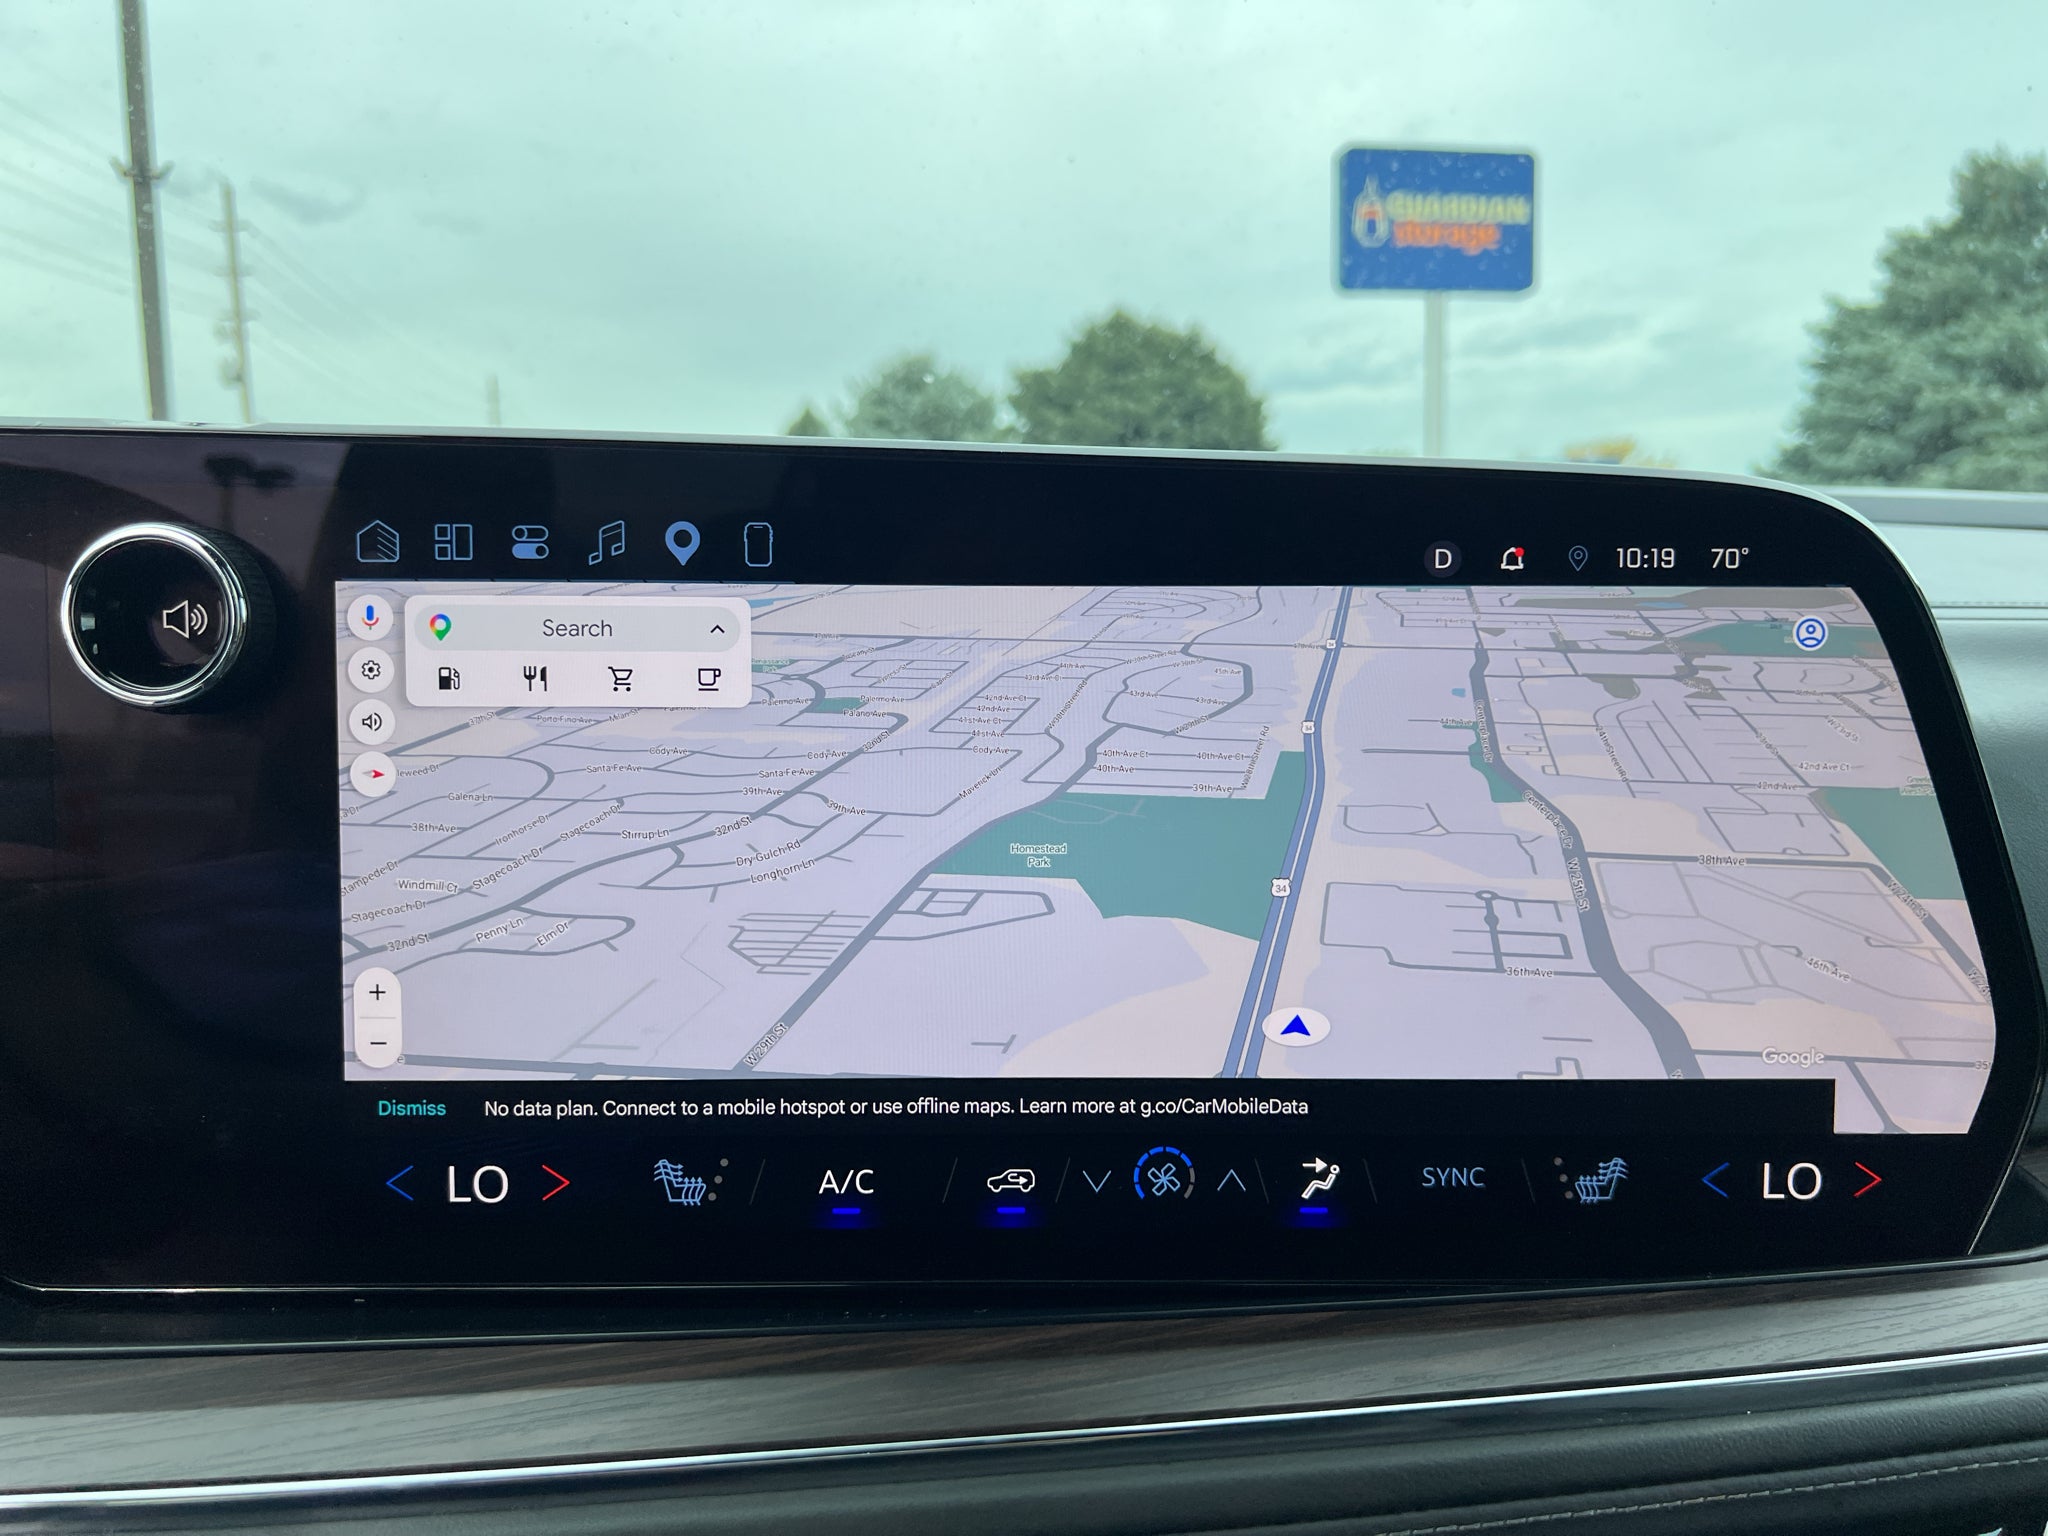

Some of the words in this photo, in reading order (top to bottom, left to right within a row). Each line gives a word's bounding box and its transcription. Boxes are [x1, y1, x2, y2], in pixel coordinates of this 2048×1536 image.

[1435, 548, 1452, 569] D
[1616, 547, 1675, 569] 10:19
[1711, 547, 1749, 569] 70°
[542, 618, 613, 638] Search
[860, 694, 890, 703] Palermo
[1066, 686, 1082, 707] Street
[1079, 679, 1089, 691] Rd
[761, 698, 790, 707] Palermo
[536, 715, 558, 723] Porto
[872, 710, 888, 718] Ave
[863, 736, 881, 752] 32nd
[881, 730, 891, 741] St
[990, 730, 1005, 738] Ave
[649, 746, 671, 756] Cody
[671, 746, 688, 755] Ave
[807, 751, 829, 760] Cody
[831, 750, 847, 758] Ave
[972, 745, 993, 755] Cody
[1102, 750, 1121, 758] 40th
[1123, 750, 1138, 758] Ave
[1139, 750, 1149, 758] Ct
[1219, 752, 1234, 760] Ave
[1235, 752, 1245, 760] Ct
[397, 767, 428, 777] leweed
[429, 763, 440, 772] Dr
[586, 765, 611, 774] Santa
[613, 764, 623, 772] Fe
[758, 769, 783, 778] Santa
[785, 768, 797, 776] Fe
[798, 768, 815, 776] Ave
[1096, 764, 1117, 773] 40th
[1119, 765, 1135, 773] Ave
[1799, 762, 1820, 771] 42nd
[1822, 763, 1838, 771] Ave
[1840, 762, 1850, 771] Ct
[959, 773, 991, 799] Maverick
[990, 767, 1002, 777] Ln
[1192, 784, 1213, 792] 39th
[1215, 785, 1233, 793] Ave
[1757, 782, 1779, 790] 42nd
[1782, 782, 1798, 791] Ave
[447, 793, 480, 801] Galena
[482, 793, 494, 801] Ln
[742, 786, 764, 796] 39th
[766, 787, 783, 796] Ave
[348, 806, 360, 815] Dr
[827, 800, 848, 814] 39th
[849, 807, 866, 815] Ave
[560, 811, 611, 842] Stagecoach
[609, 804, 621, 814] Dr
[1523, 790, 1566, 836] Centerplace
[1562, 836, 1573, 848] Dr
[411, 822, 435, 832] 38th
[438, 824, 457, 833] Ave
[495, 819, 538, 846] Ironhorse
[538, 814, 549, 824] Dr
[621, 829, 655, 840] Stirrup
[657, 828, 670, 838] Ln
[714, 821, 739, 837] 32nd
[739, 817, 752, 828] St
[736, 856, 753, 867] Dry
[755, 847, 786, 864] Gulch
[786, 840, 801, 852] Rd
[1010, 843, 1067, 854] Homestead
[472, 851, 531, 890] Stagecoach
[530, 846, 544, 859] Dr
[1028, 857, 1050, 867] Park
[1568, 857, 1580, 871] W
[1699, 855, 1722, 866] 38th
[1726, 857, 1745, 867] Ave
[750, 863, 801, 883] Longhorn
[801, 858, 815, 869] Ln
[340, 864, 387, 897] Stampede
[386, 861, 398, 871] Dr
[398, 880, 445, 891] Windmill
[447, 882, 458, 893] Ct
[1570, 871, 1585, 898] 25th
[1275, 884, 1287, 893] 34
[351, 903, 413, 923] Stagecoach
[414, 900, 427, 910] Dr
[1576, 897, 1590, 912] St
[1916, 908, 1928, 920] St
[475, 922, 509, 943] Penny
[509, 917, 524, 929] Ln
[536, 931, 557, 947] Elm
[557, 921, 570, 934] Dr
[387, 937, 416, 952] 32nd
[416, 933, 430, 944] St
[1506, 967, 1530, 977] 36th
[1534, 968, 1553, 978] Ave
[1806, 956, 1830, 974] 46th
[1830, 967, 1850, 982] Ave
[744, 1053, 757, 1068] W
[755, 1033, 777, 1057] 29th
[774, 1022, 788, 1036] St
[1762, 1047, 1825, 1068] Google
[378, 1100, 447, 1117] Dismiss
[484, 1101, 510, 1117] No
[513, 1101, 553, 1117] data
[556, 1101, 599, 1120] plan.
[603, 1101, 676, 1117] Connect
[681, 1101, 699, 1116] to
[702, 1103, 713, 1117] a
[718, 1099, 776, 1116] mobile
[780, 1099, 845, 1120] hotspot
[849, 1102, 869, 1116] or
[872, 1102, 903, 1116] use
[907, 1098, 960, 1115] offline
[964, 1102, 1015, 1118] maps.
[1020, 1098, 1067, 1115] Learn
[1071, 1101, 1115, 1116] more
[1119, 1100, 1136, 1115] at
[1140, 1098, 1309, 1119] g.co/CarMobileData
[447, 1164, 509, 1204] LO
[818, 1168, 875, 1195] A/C
[1422, 1166, 1486, 1187] SYNC
[1763, 1161, 1823, 1201] LO
